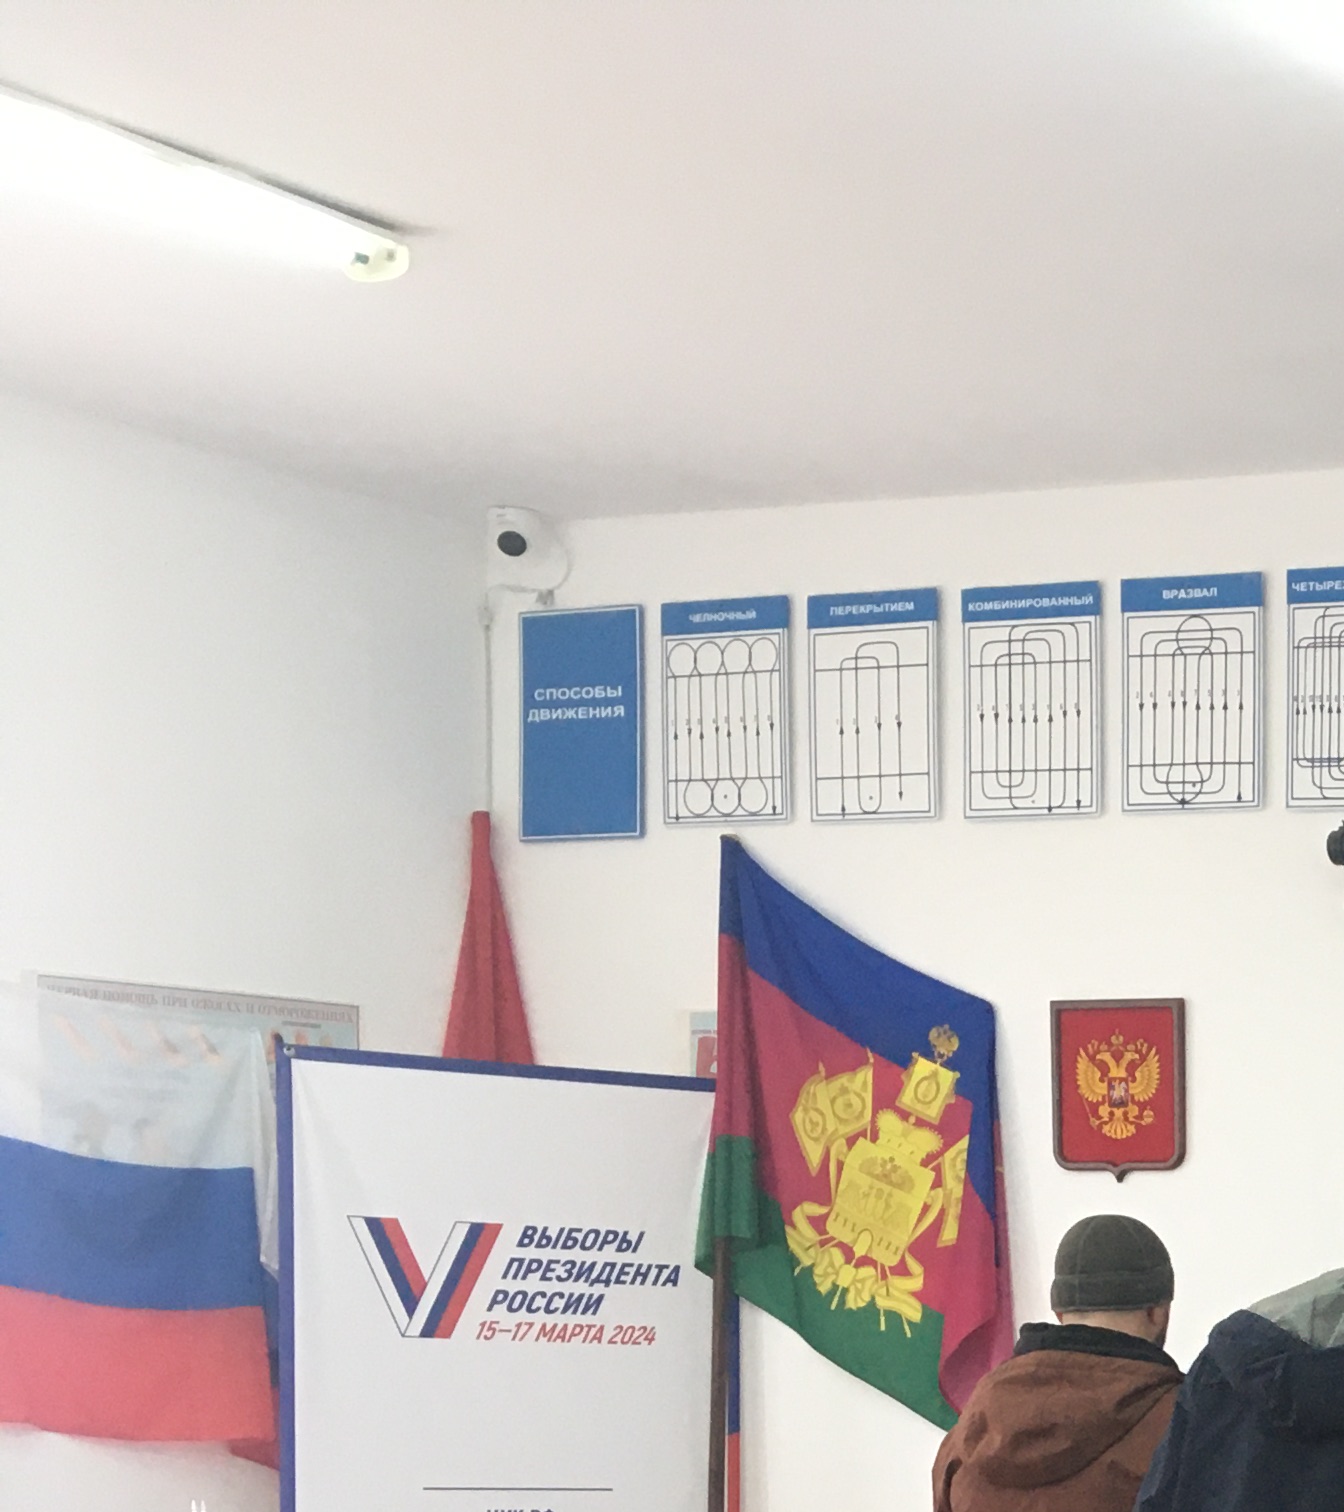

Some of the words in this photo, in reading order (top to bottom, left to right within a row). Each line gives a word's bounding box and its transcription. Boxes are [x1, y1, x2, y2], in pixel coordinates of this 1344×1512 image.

[968, 592, 1094, 612] КОМБИНИРОВАННЫЙ
[1162, 586, 1218, 599] ВРАЗВАЛ
[689, 608, 757, 624] ЧЕЛНОЧНЫЙ
[829, 601, 915, 616] ПЕРЕКРЫТИЕМ
[534, 685, 623, 702] СПОСОБЫ
[527, 704, 625, 724] ДВИЖЕНИЯ
[516, 1224, 645, 1254] ВЫБОРЫ
[500, 1257, 682, 1288] ПРЕЗИДЕНТА
[486, 1289, 605, 1317] РОССИИ
[534, 1322, 601, 1345] МАРТА
[607, 1325, 657, 1347] 2024
